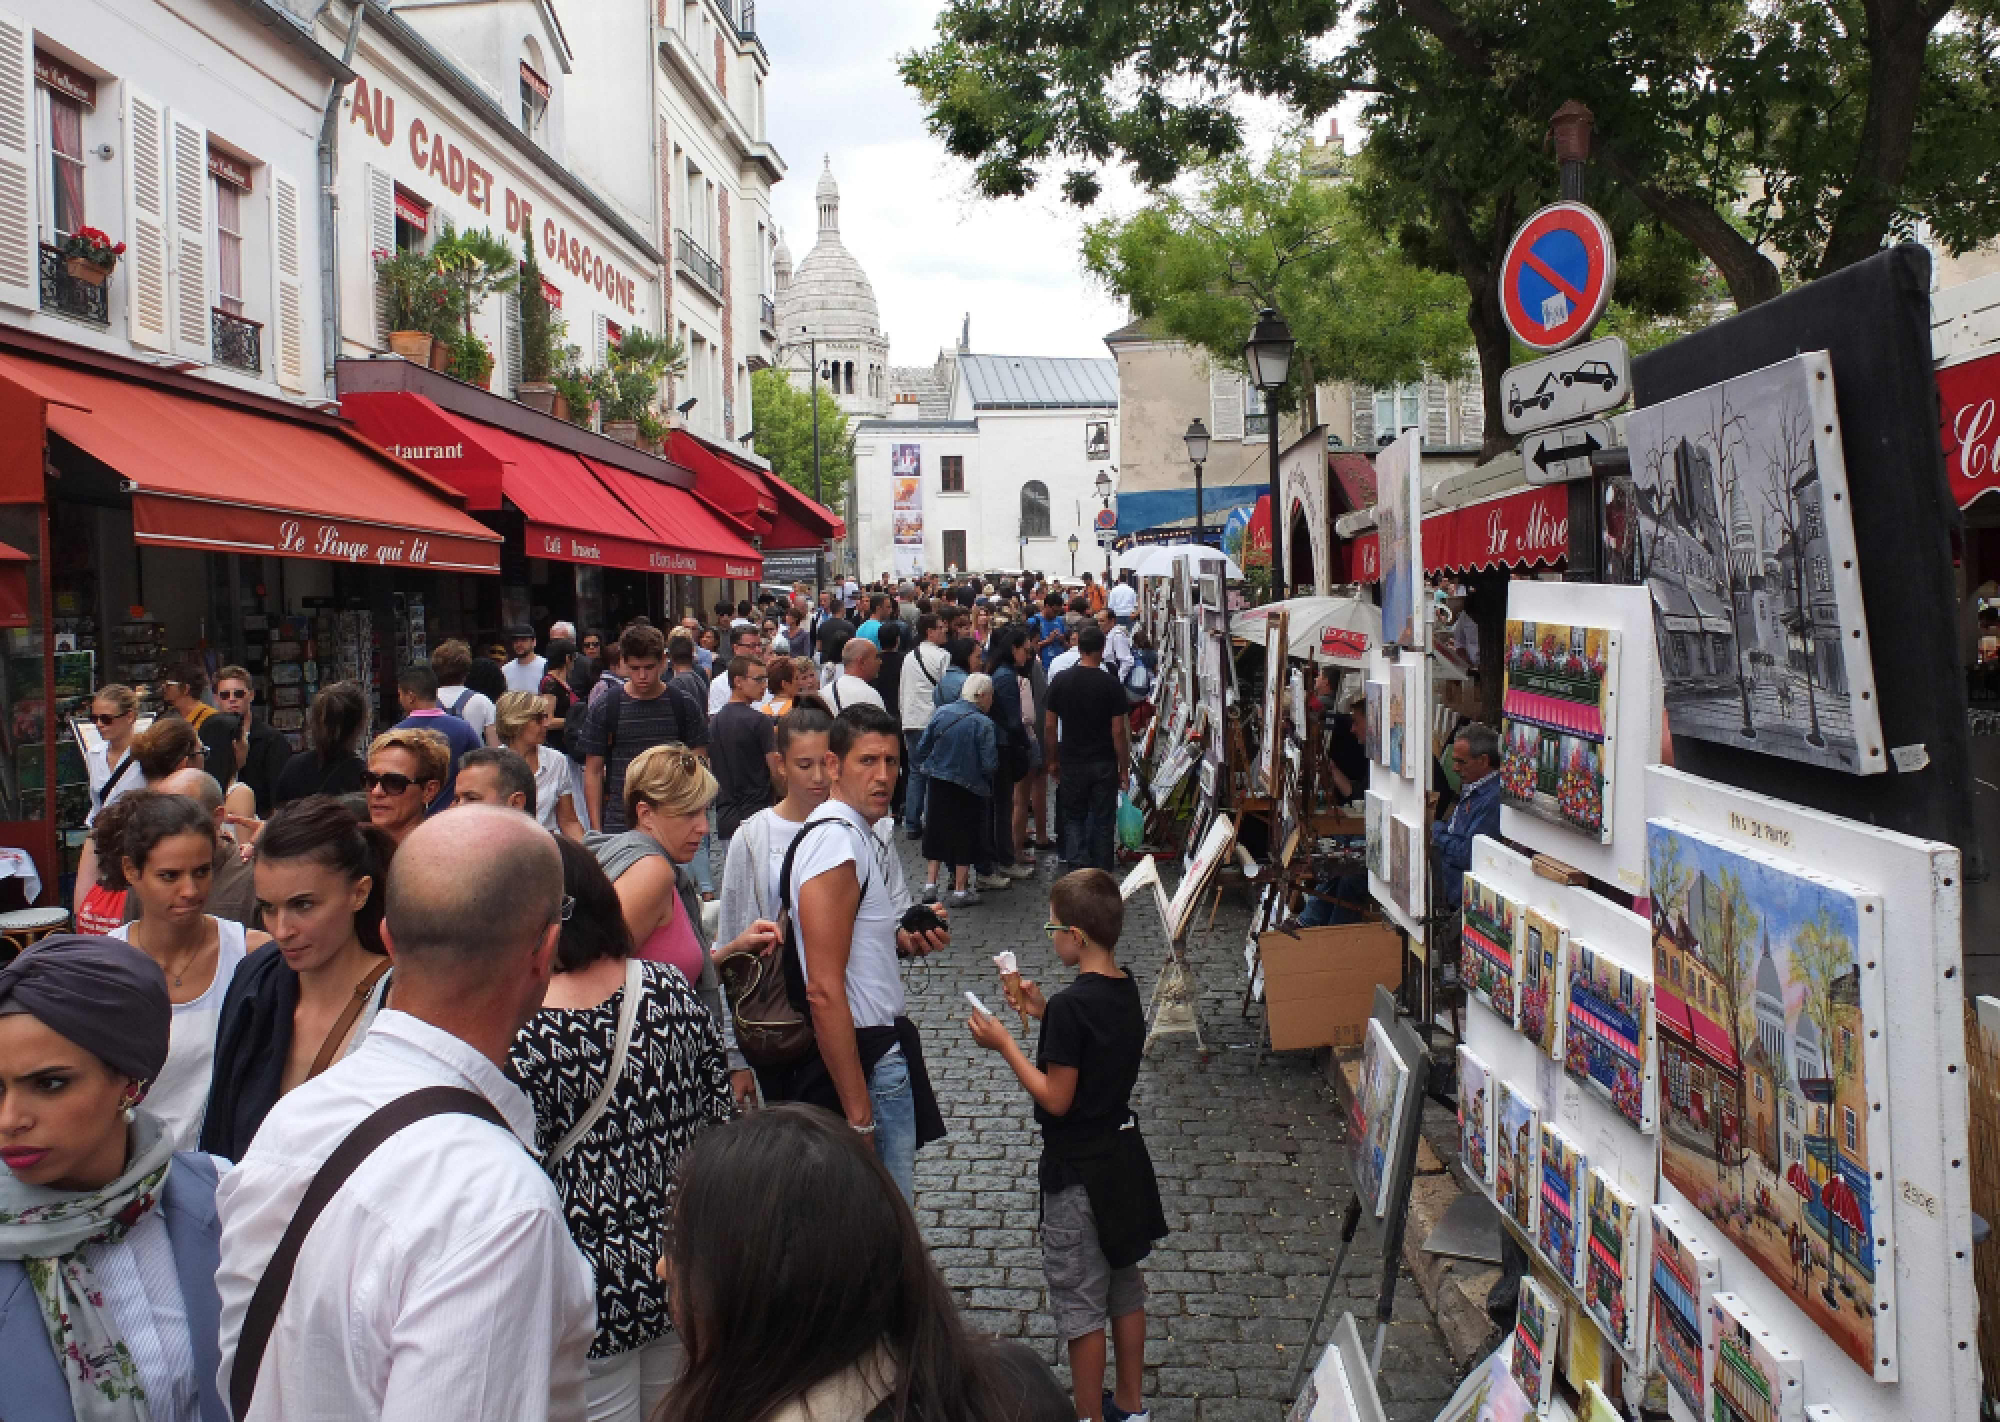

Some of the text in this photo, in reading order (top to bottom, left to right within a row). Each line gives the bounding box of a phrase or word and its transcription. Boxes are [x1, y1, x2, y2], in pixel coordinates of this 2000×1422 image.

[350, 75, 636, 315] AU CADET DE GASCOGNE
[1953, 398, 2000, 478] C
[278, 519, 429, 565] Le Singe qui lit
